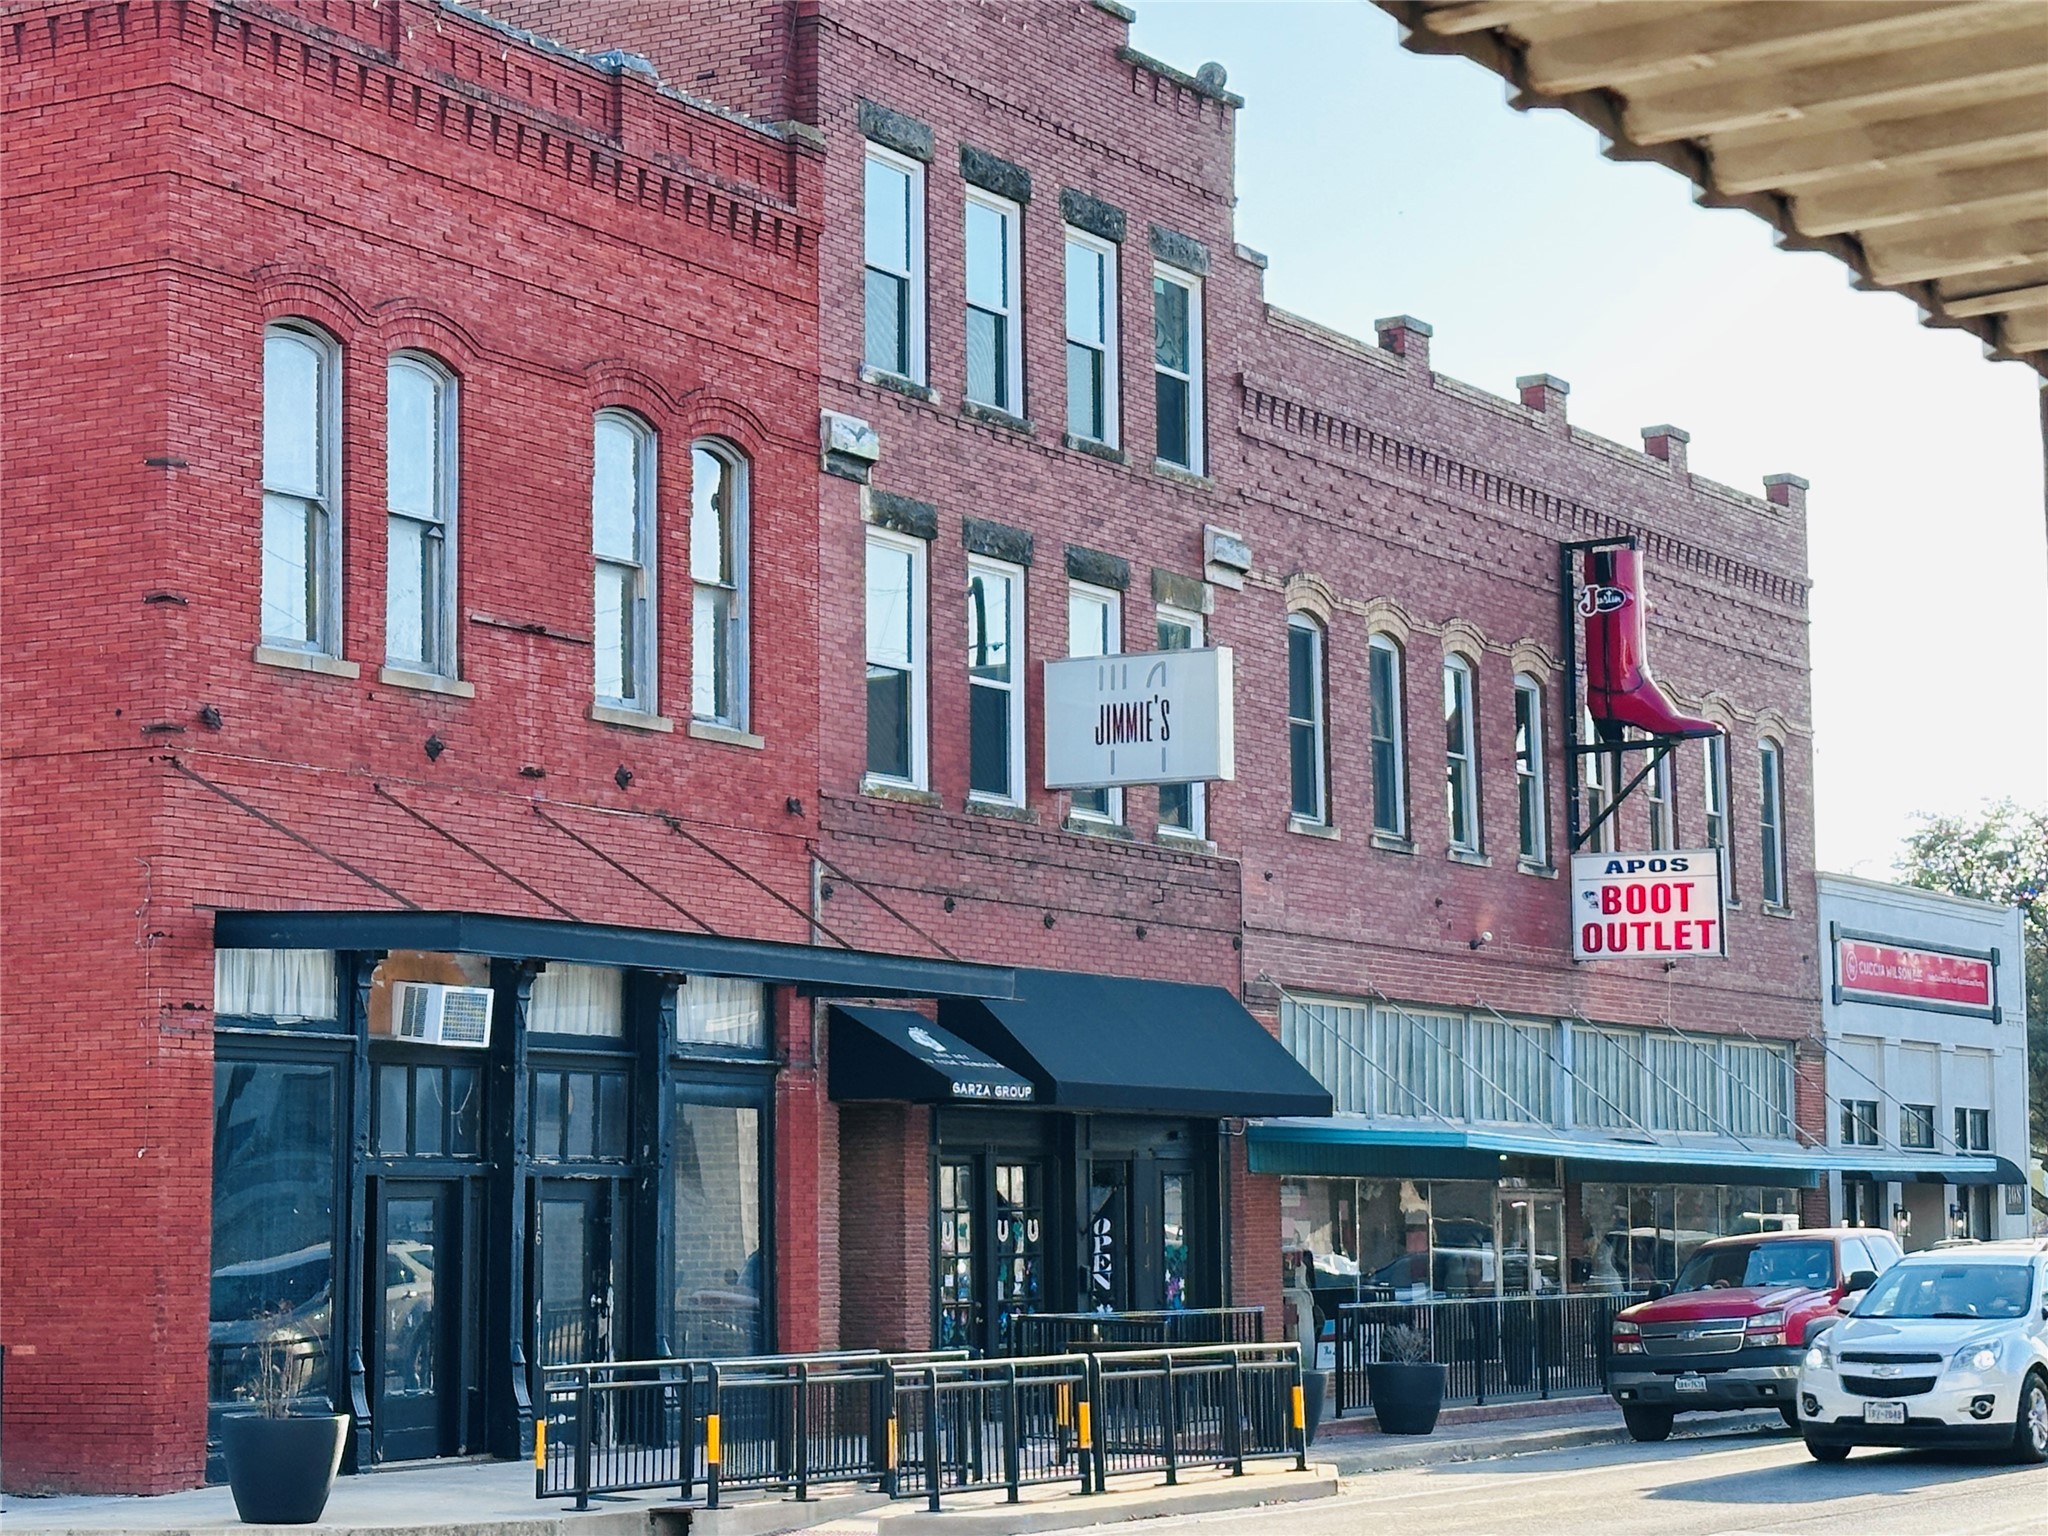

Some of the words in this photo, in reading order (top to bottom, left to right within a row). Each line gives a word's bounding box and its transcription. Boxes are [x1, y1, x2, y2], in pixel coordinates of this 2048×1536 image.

[1095, 694, 1170, 746] JIMMIE'S
[1604, 858, 1689, 874] APOS
[1602, 882, 1694, 915] BOOT
[1582, 919, 1716, 953] OUTLET
[952, 1081, 991, 1097] GARZA
[994, 1085, 1032, 1099] GROUP
[1092, 1217, 1112, 1291] OPEN
